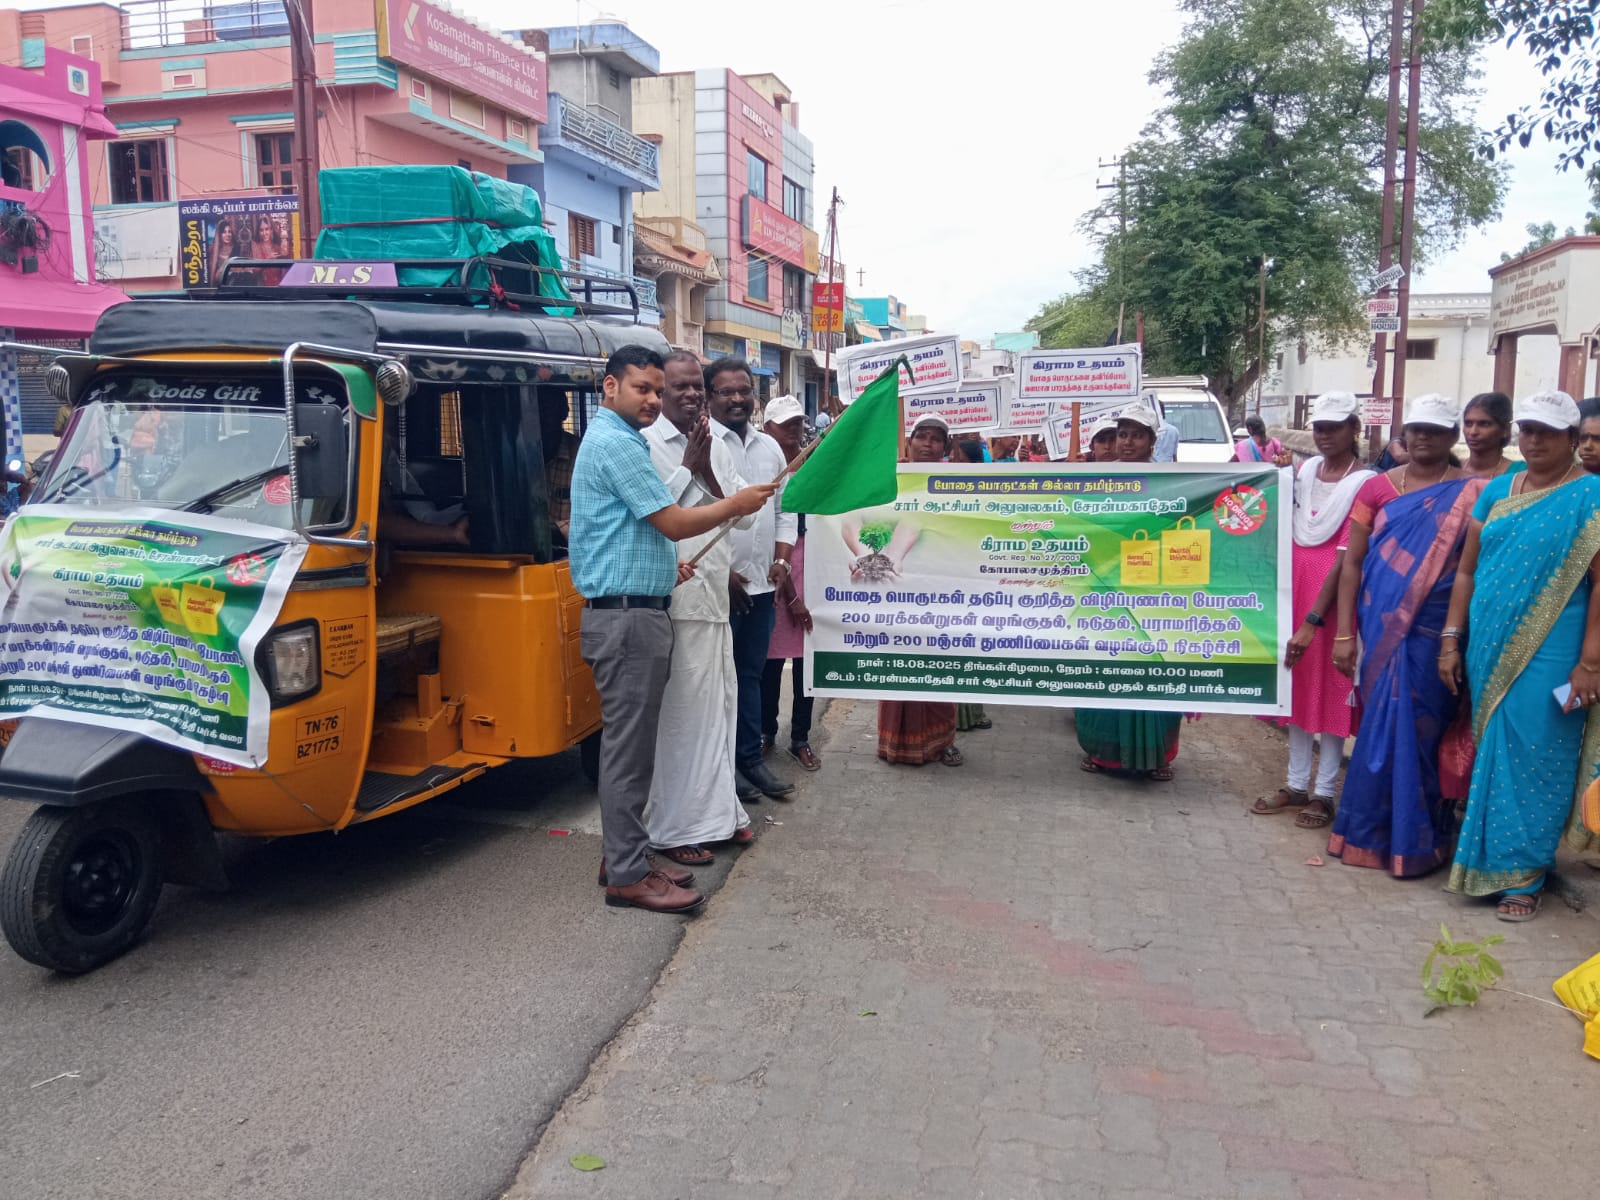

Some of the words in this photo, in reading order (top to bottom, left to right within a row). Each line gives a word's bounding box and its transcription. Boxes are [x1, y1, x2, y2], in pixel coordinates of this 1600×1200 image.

[426, 11, 485, 54] Kosamattam
[487, 43, 520, 70] Finance
[522, 61, 538, 81] Ltd.
[182, 203, 210, 215] லக்கி
[212, 201, 246, 215] சூப்பர்
[309, 265, 373, 285] M.S
[1033, 359, 1074, 371] கிராம
[1077, 357, 1125, 370] உதயம்
[148, 384, 207, 399] Gods
[213, 385, 262, 401] Gift
[910, 397, 945, 409] கிராம
[946, 393, 986, 405] உதயம்
[934, 479, 975, 492] போதை
[978, 479, 1039, 492] பொருட்கள்
[1041, 479, 1080, 491] இல்லா
[1083, 478, 1141, 493] தமிழ்நாடு
[894, 498, 919, 512] சார்
[923, 499, 981, 513] ஆட்சியர்
[985, 499, 1071, 515] அலுவலகம்,
[1073, 497, 1186, 515] சேரன்மகாதேவி
[1222, 495, 1235, 507] NO
[980, 536, 1027, 552] கிராம
[1031, 536, 1089, 553] உதயம்
[53, 568, 91, 581] கிராம
[94, 572, 143, 588] உதயம்
[980, 564, 1089, 576] கோபாலசமுத்திரம்
[824, 586, 882, 605] போதை
[886, 590, 965, 606] பொருட்கள்
[968, 591, 1013, 608] தடுப்பு
[1018, 592, 1075, 609] குறித்த
[1081, 592, 1187, 610] விழிப்புணர்வு
[1193, 592, 1263, 610] பேரணி,
[842, 612, 871, 623] 200
[875, 611, 978, 629] மரக்கன்றுகள்
[982, 613, 1071, 631] வழங்குதல்,
[1077, 615, 1135, 632] நடுதல்,
[1142, 616, 1241, 633] பராமரித்தல்
[103, 625, 139, 641] குறித்த
[844, 631, 889, 649] மற்றும்
[894, 635, 921, 646] 200
[927, 633, 976, 650] மஞ்சள்
[981, 635, 1089, 652] துணிப்பைகள்
[1095, 638, 1168, 656] வழங்கும்
[1174, 638, 1240, 659] நிகழ்ச்சி
[857, 658, 884, 668] நாள்
[893, 659, 961, 670] 18.08.2025
[964, 661, 1053, 675] திங்கள்கிழமை,
[1056, 664, 1092, 676] நேரம்
[1102, 667, 1145, 677] காலை
[1149, 667, 1186, 677] 10.00
[1189, 668, 1223, 678] மணி
[825, 671, 855, 682] இடம்
[864, 672, 954, 686] சேரன்மகாதேவி
[957, 676, 980, 686] சார்
[982, 677, 1033, 688] ஆட்சியர்
[1036, 680, 1105, 691] அலுவலகம்
[1108, 681, 1144, 693] முதல்
[1147, 682, 1187, 694] காந்தி
[1189, 683, 1225, 694] பார்க்
[1228, 686, 1262, 696] வரை
[305, 715, 339, 735] TN-76
[297, 736, 339, 759] BZ1773
